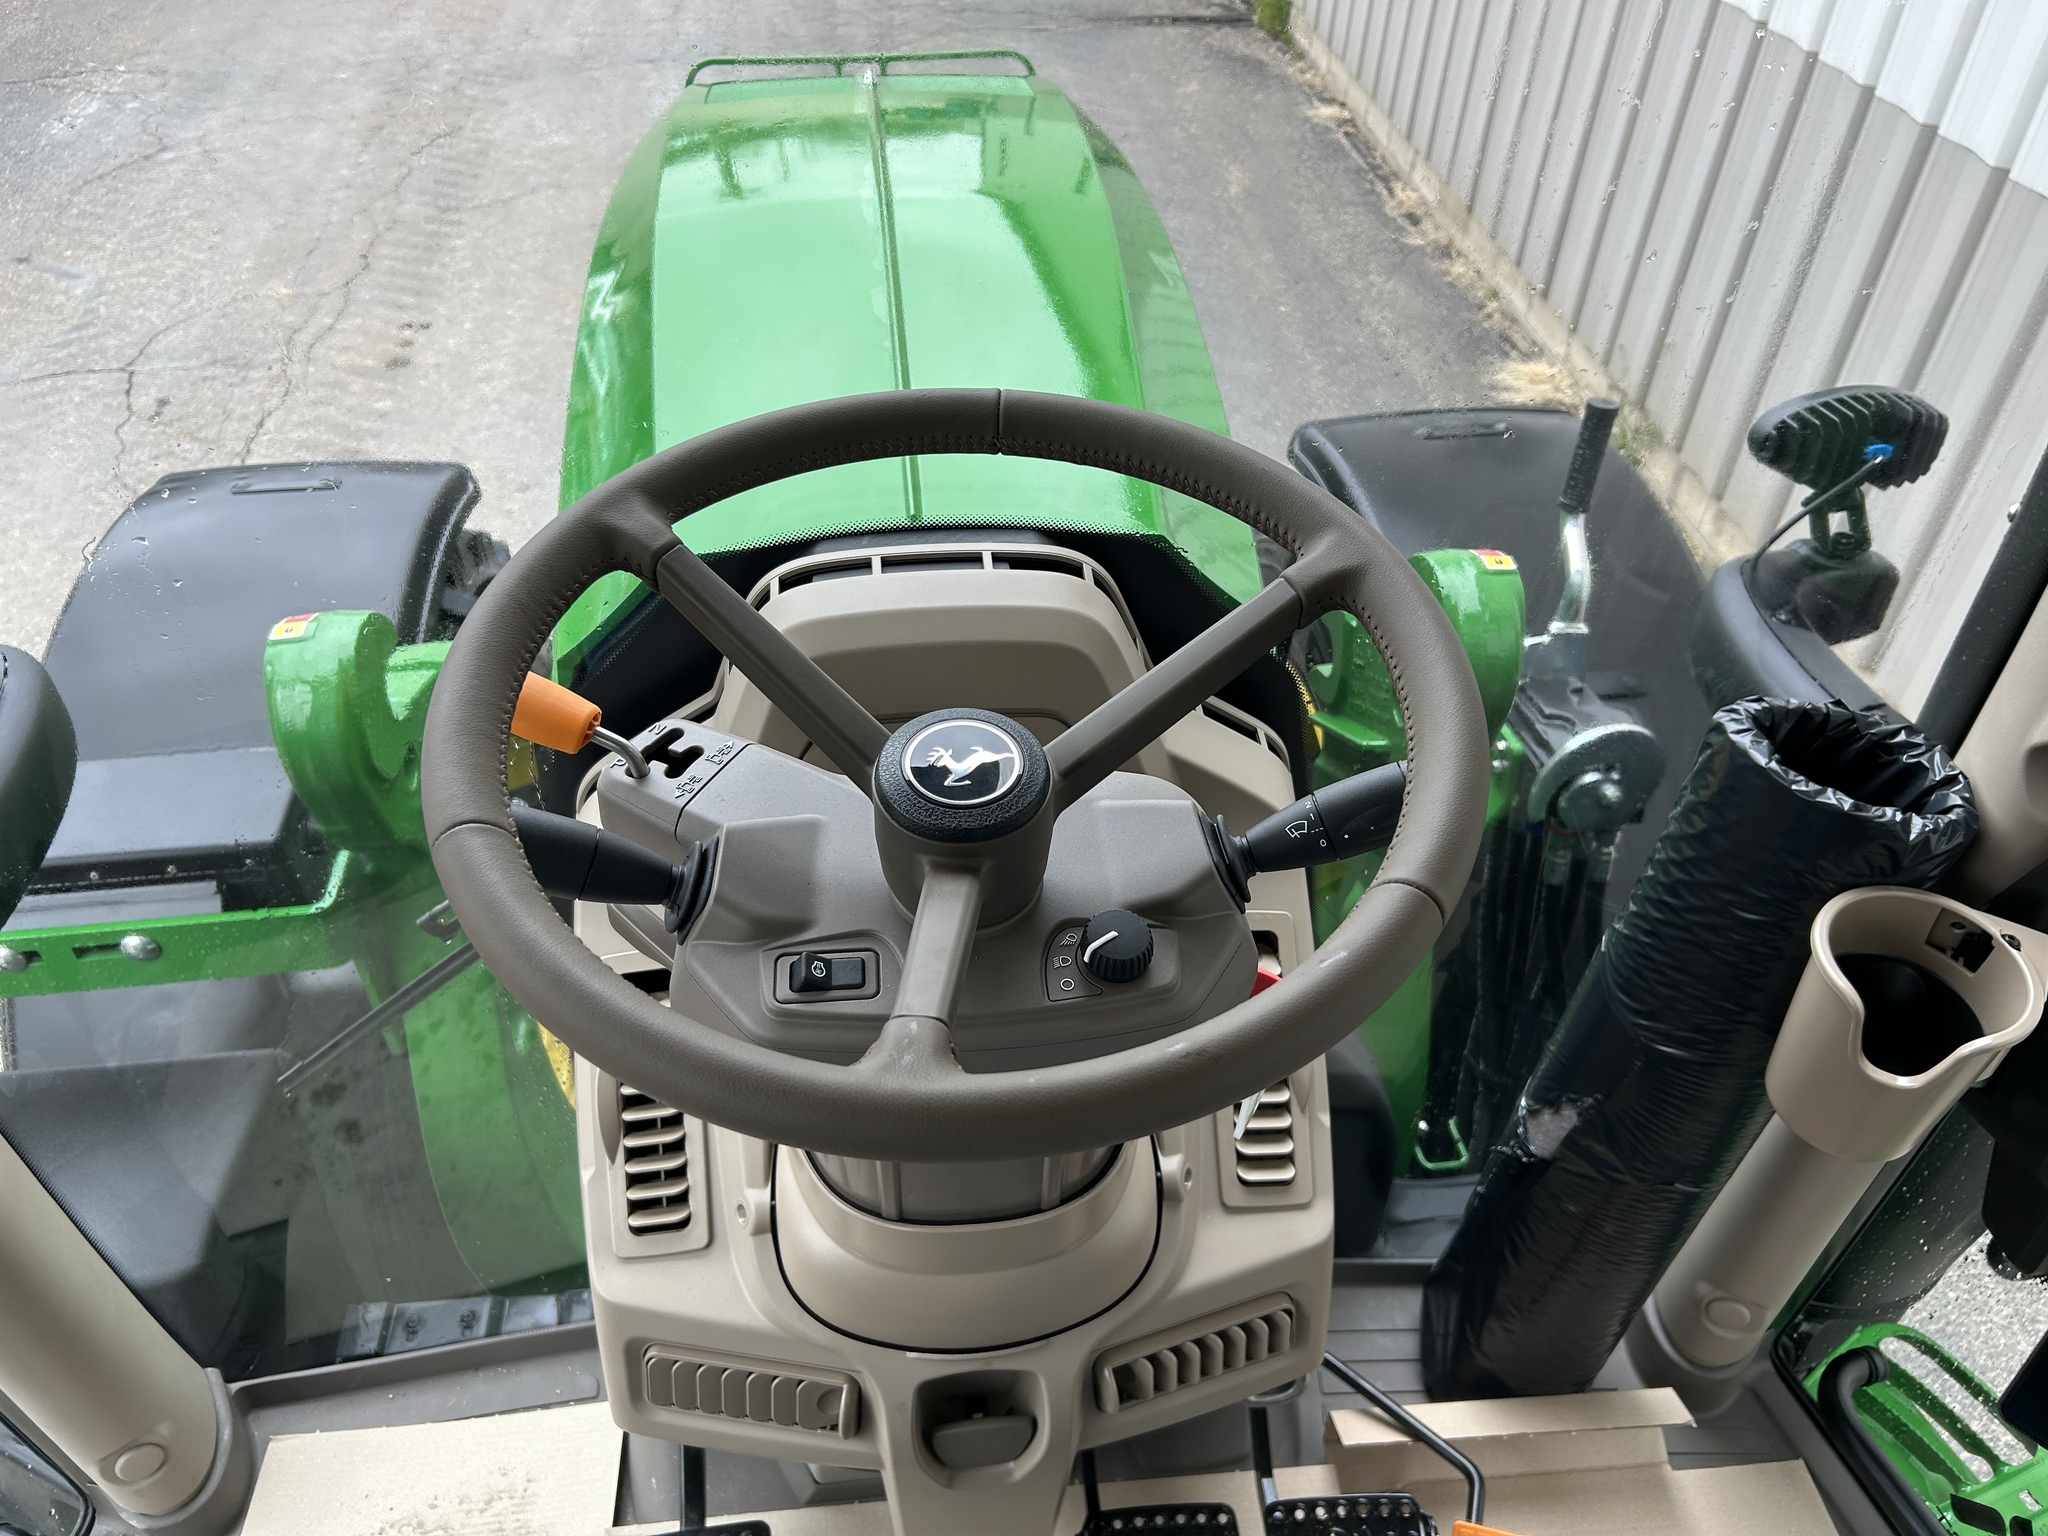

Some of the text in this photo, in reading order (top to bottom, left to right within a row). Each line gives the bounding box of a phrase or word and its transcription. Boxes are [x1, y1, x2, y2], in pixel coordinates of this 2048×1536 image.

[648, 722, 667, 735] N
[609, 759, 627, 769] P
[1305, 801, 1312, 809] 2
